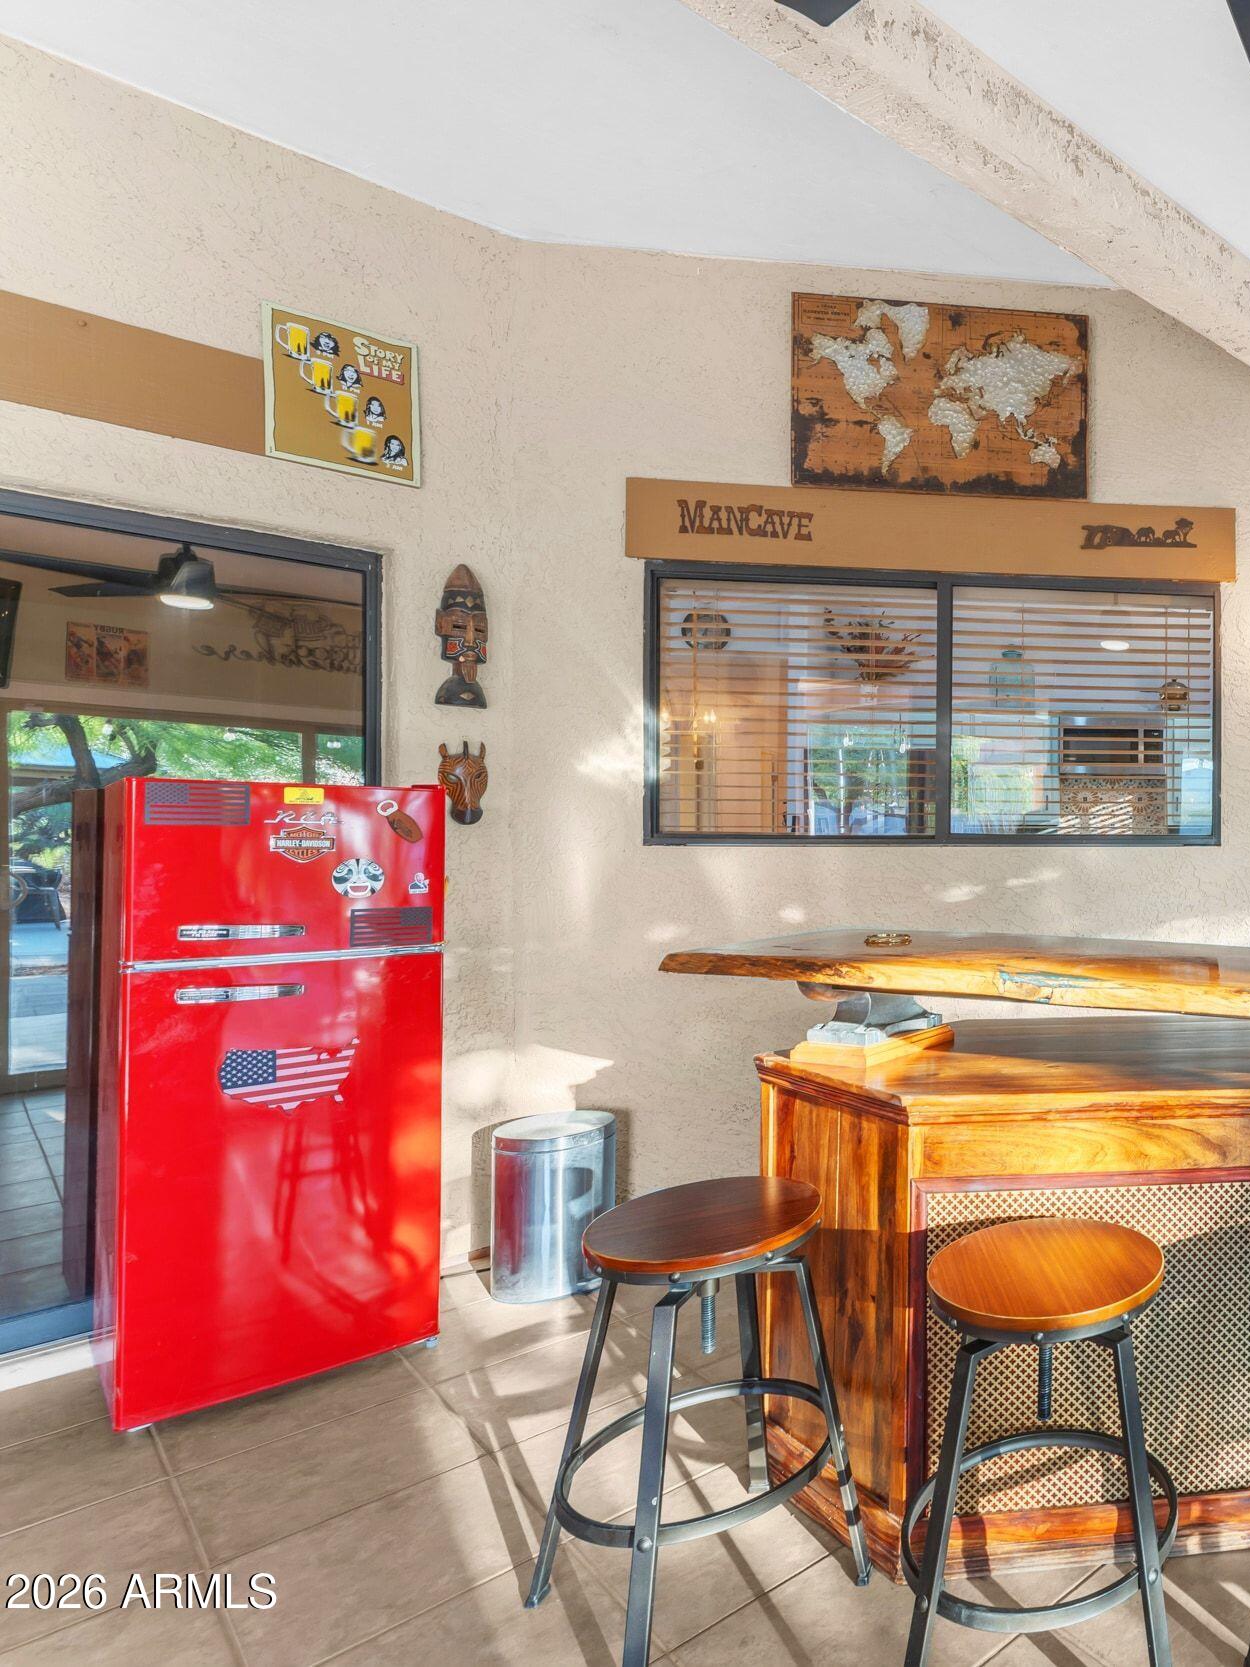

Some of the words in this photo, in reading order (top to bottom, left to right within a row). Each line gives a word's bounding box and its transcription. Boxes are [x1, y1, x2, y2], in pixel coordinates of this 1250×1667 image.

[352, 336, 404, 365] STORY
[357, 354, 403, 382] LIFE
[382, 360, 401, 370] MY
[276, 839, 331, 848] HARLEY-DAVIDSON
[286, 849, 319, 858] CYCLES
